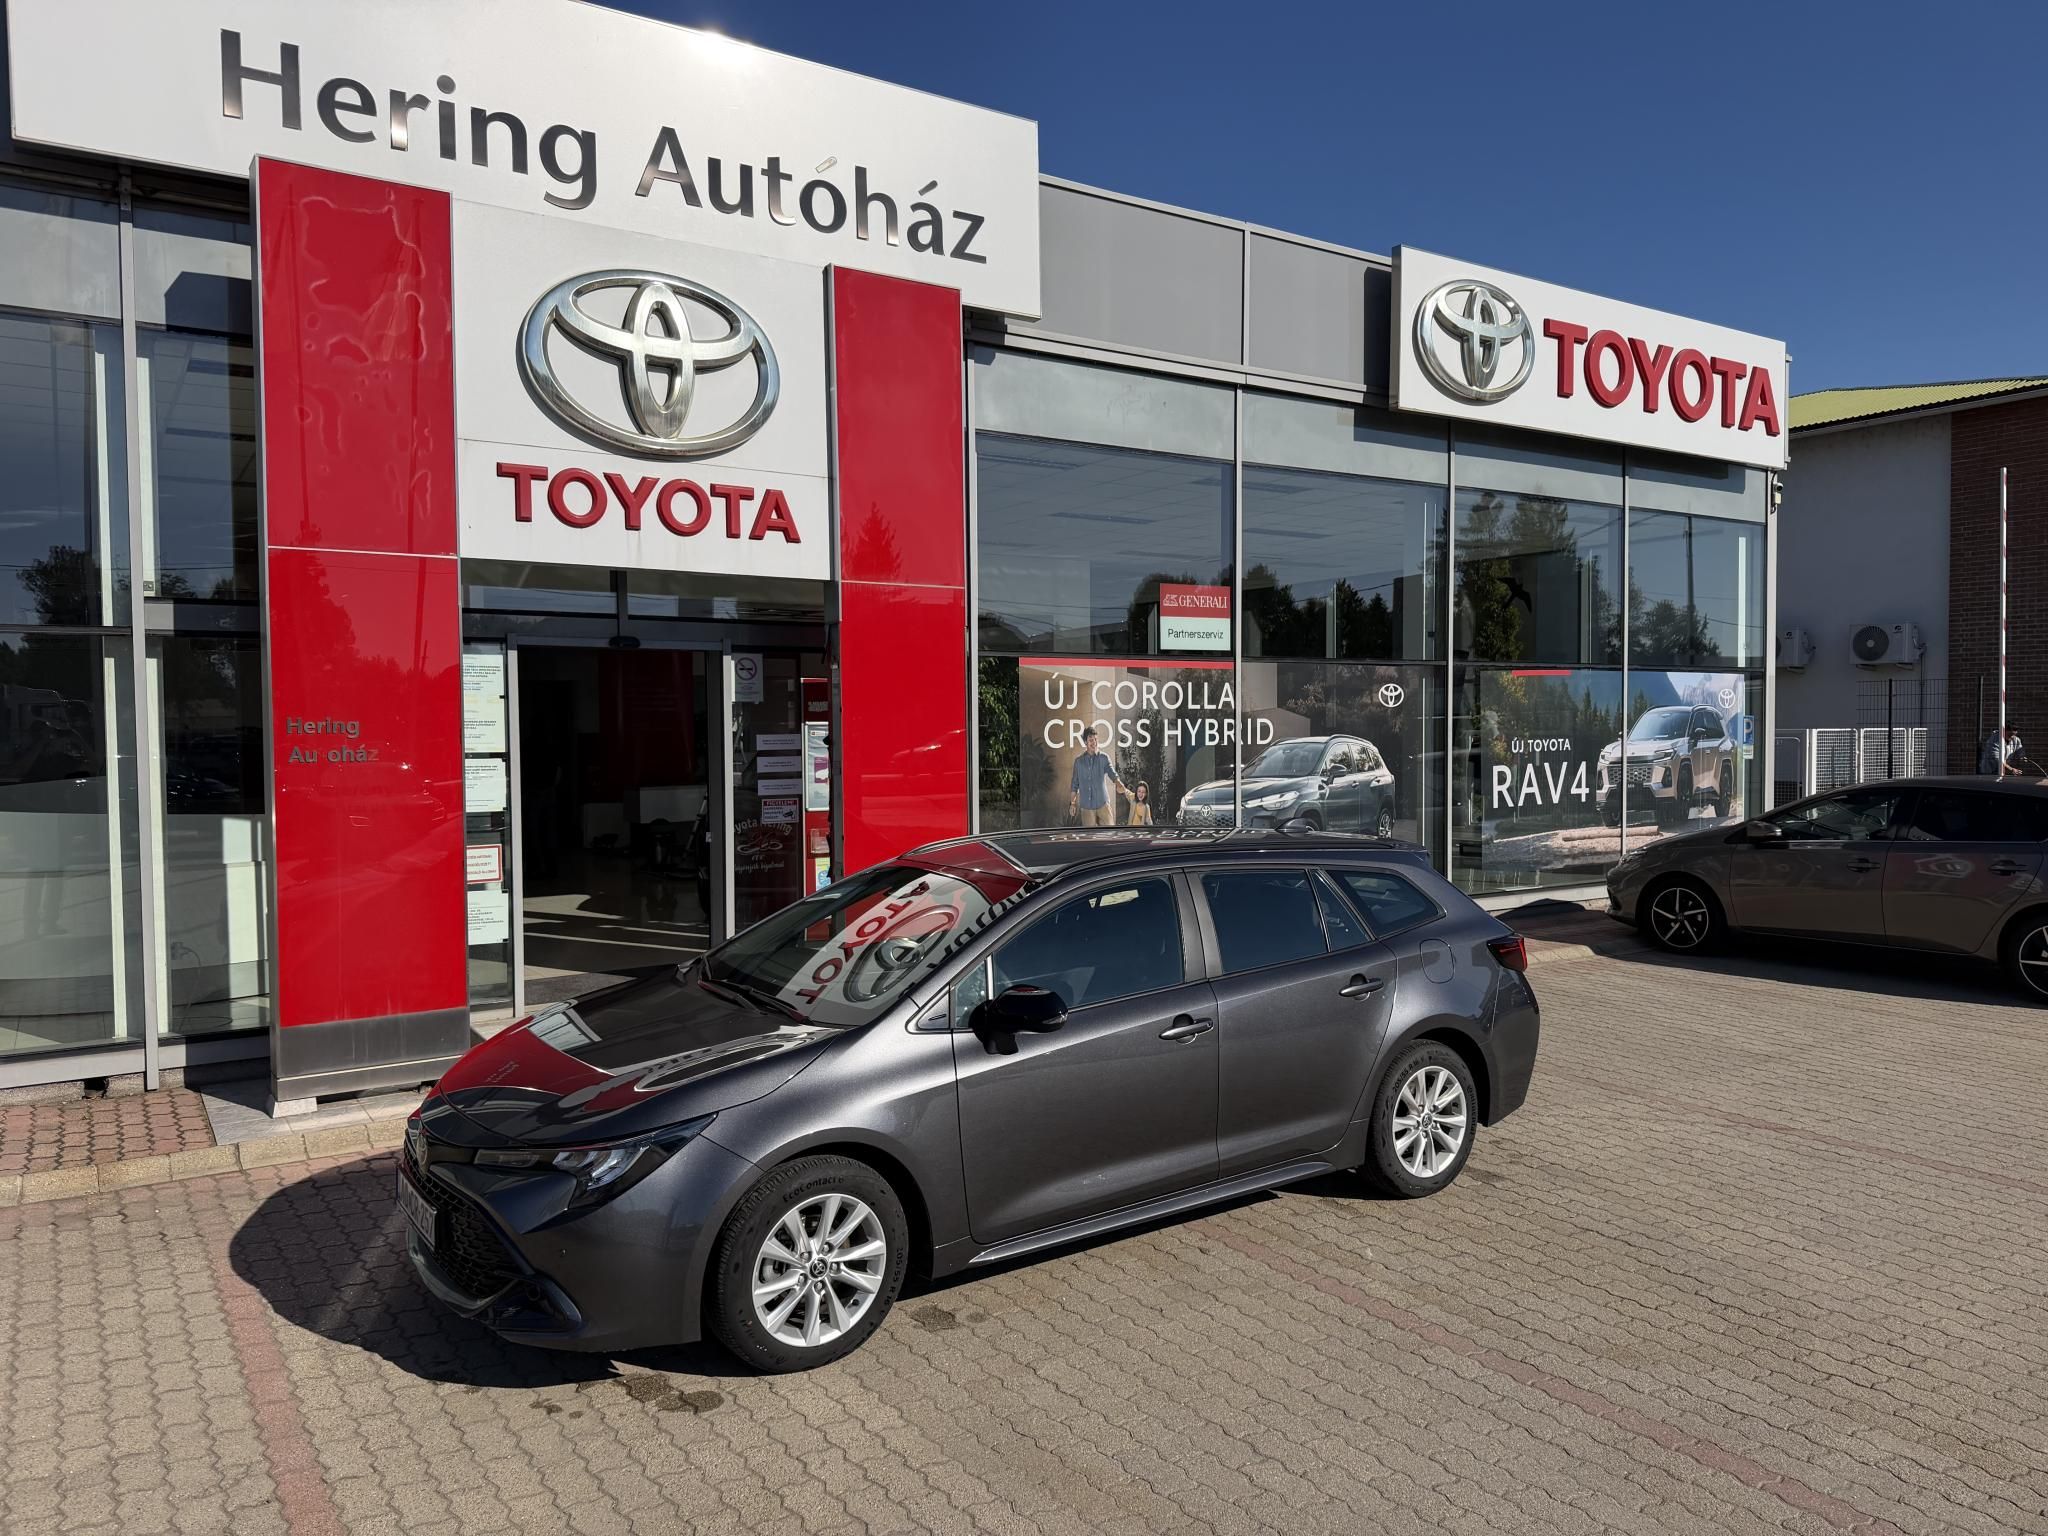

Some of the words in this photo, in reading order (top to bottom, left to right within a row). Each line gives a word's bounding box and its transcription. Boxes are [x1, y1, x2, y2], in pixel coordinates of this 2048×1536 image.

[220, 28, 598, 211] Hering
[635, 125, 988, 265] Autóház
[1543, 318, 1781, 437] TOYOTA
[496, 461, 802, 544] TOYOTA
[1179, 594, 1228, 609] GENERALI
[1167, 628, 1224, 640] Partnerszerviz
[1044, 672, 1079, 710] ÚJ
[1091, 680, 1235, 710] COROLLA
[286, 717, 360, 739] Hering
[1043, 718, 1151, 749] CROSS
[1164, 717, 1275, 747] HYBRID
[1511, 737, 1524, 753] ÚJ
[1528, 739, 1572, 753] TOYOTA
[1492, 761, 1590, 809] RAV4
